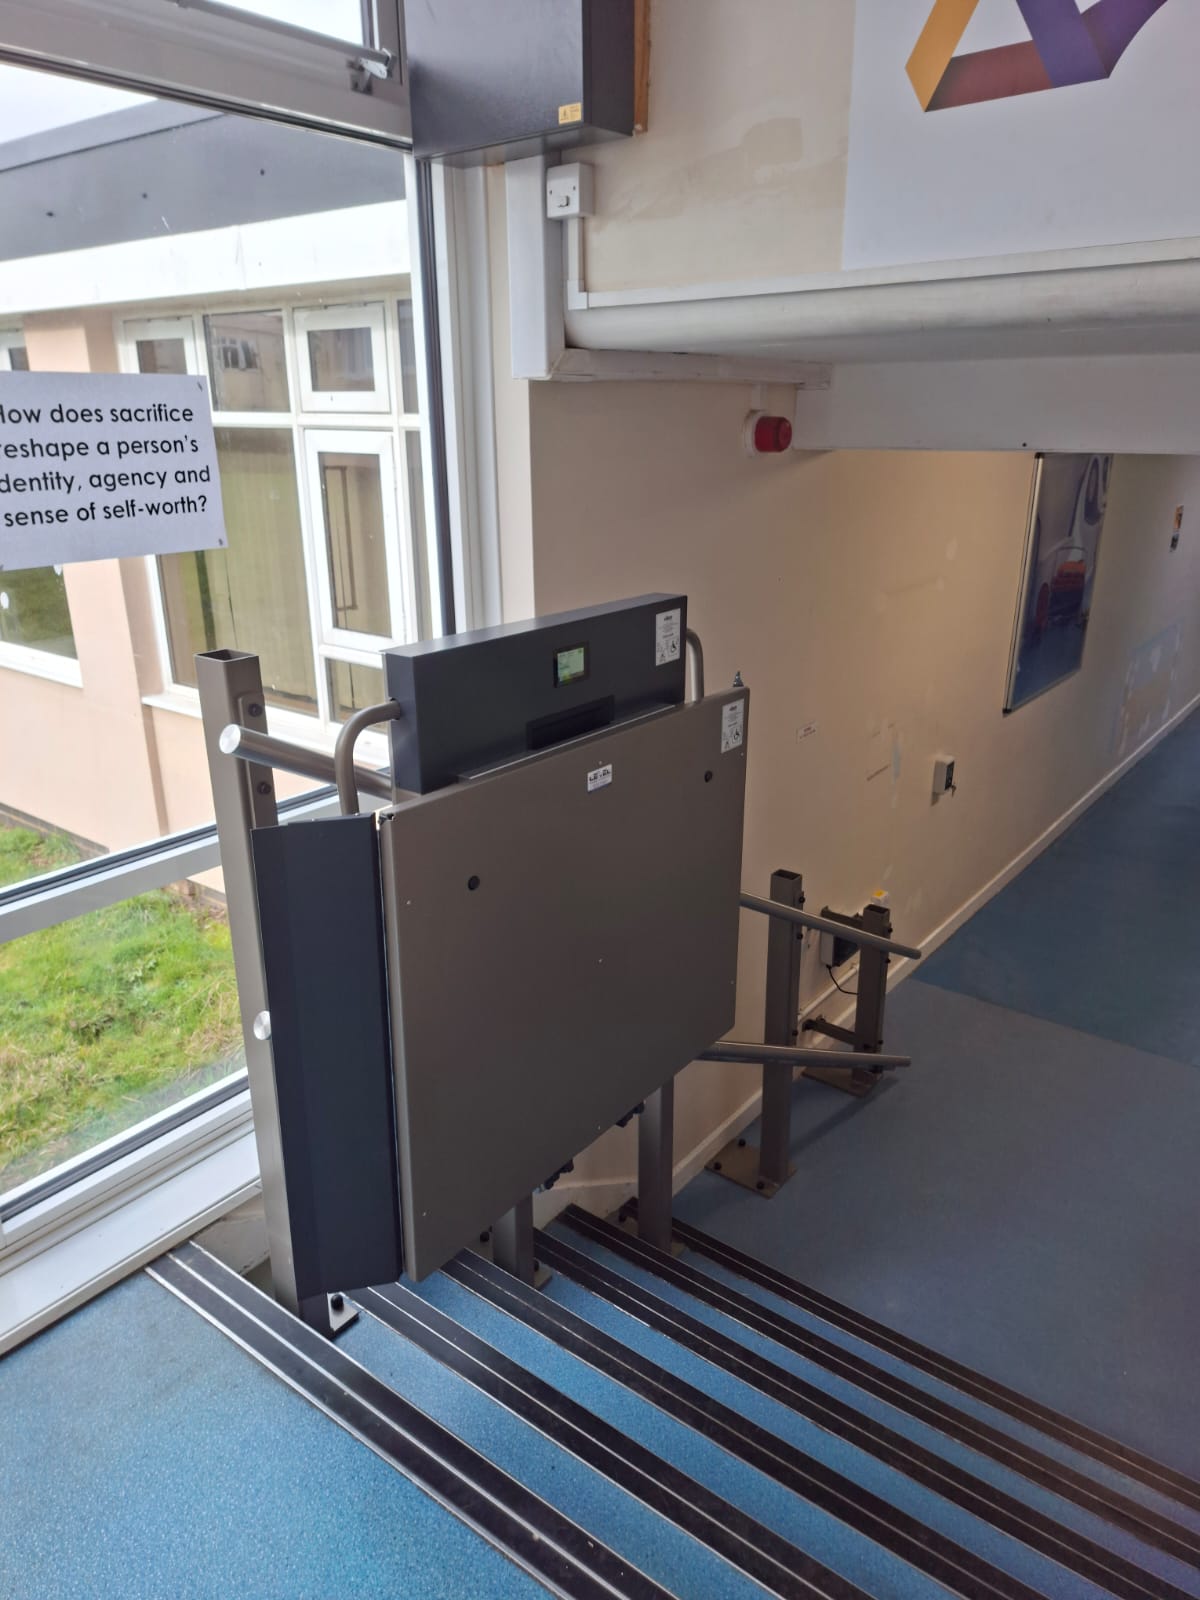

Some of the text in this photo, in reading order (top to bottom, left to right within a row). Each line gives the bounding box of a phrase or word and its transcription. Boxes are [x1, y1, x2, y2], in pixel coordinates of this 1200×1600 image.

[50, 403, 104, 423] does
[110, 403, 194, 422] sacrifice
[97, 441, 110, 455] a
[117, 434, 199, 459] person’s
[89, 471, 167, 491] agency
[174, 465, 211, 484] and
[4, 495, 207, 527] sense of self-worth?
